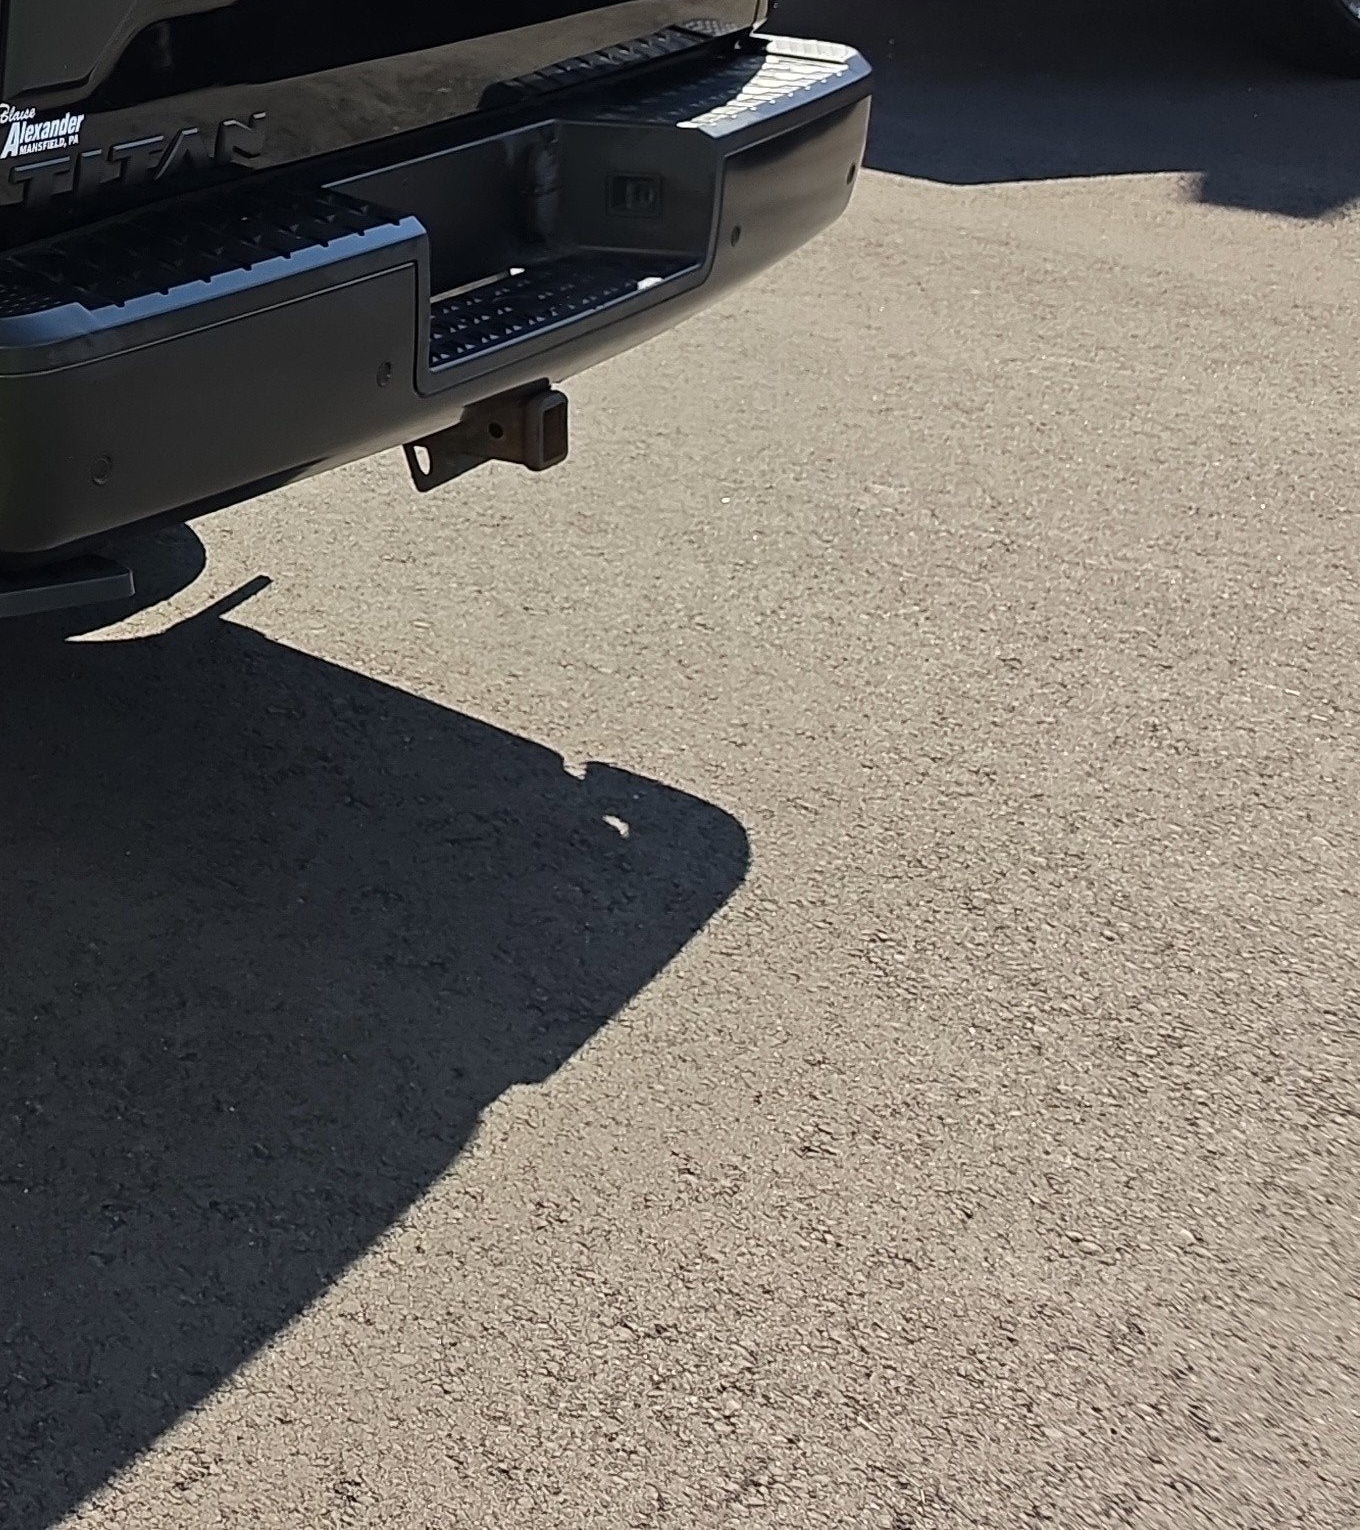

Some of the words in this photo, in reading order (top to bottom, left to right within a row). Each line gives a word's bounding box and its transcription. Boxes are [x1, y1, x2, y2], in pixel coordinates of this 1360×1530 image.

[0, 112, 85, 160] Alexander
[8, 111, 267, 202] TITAN
[19, 135, 67, 156] MANSFIELD,
[68, 134, 79, 147] PA
